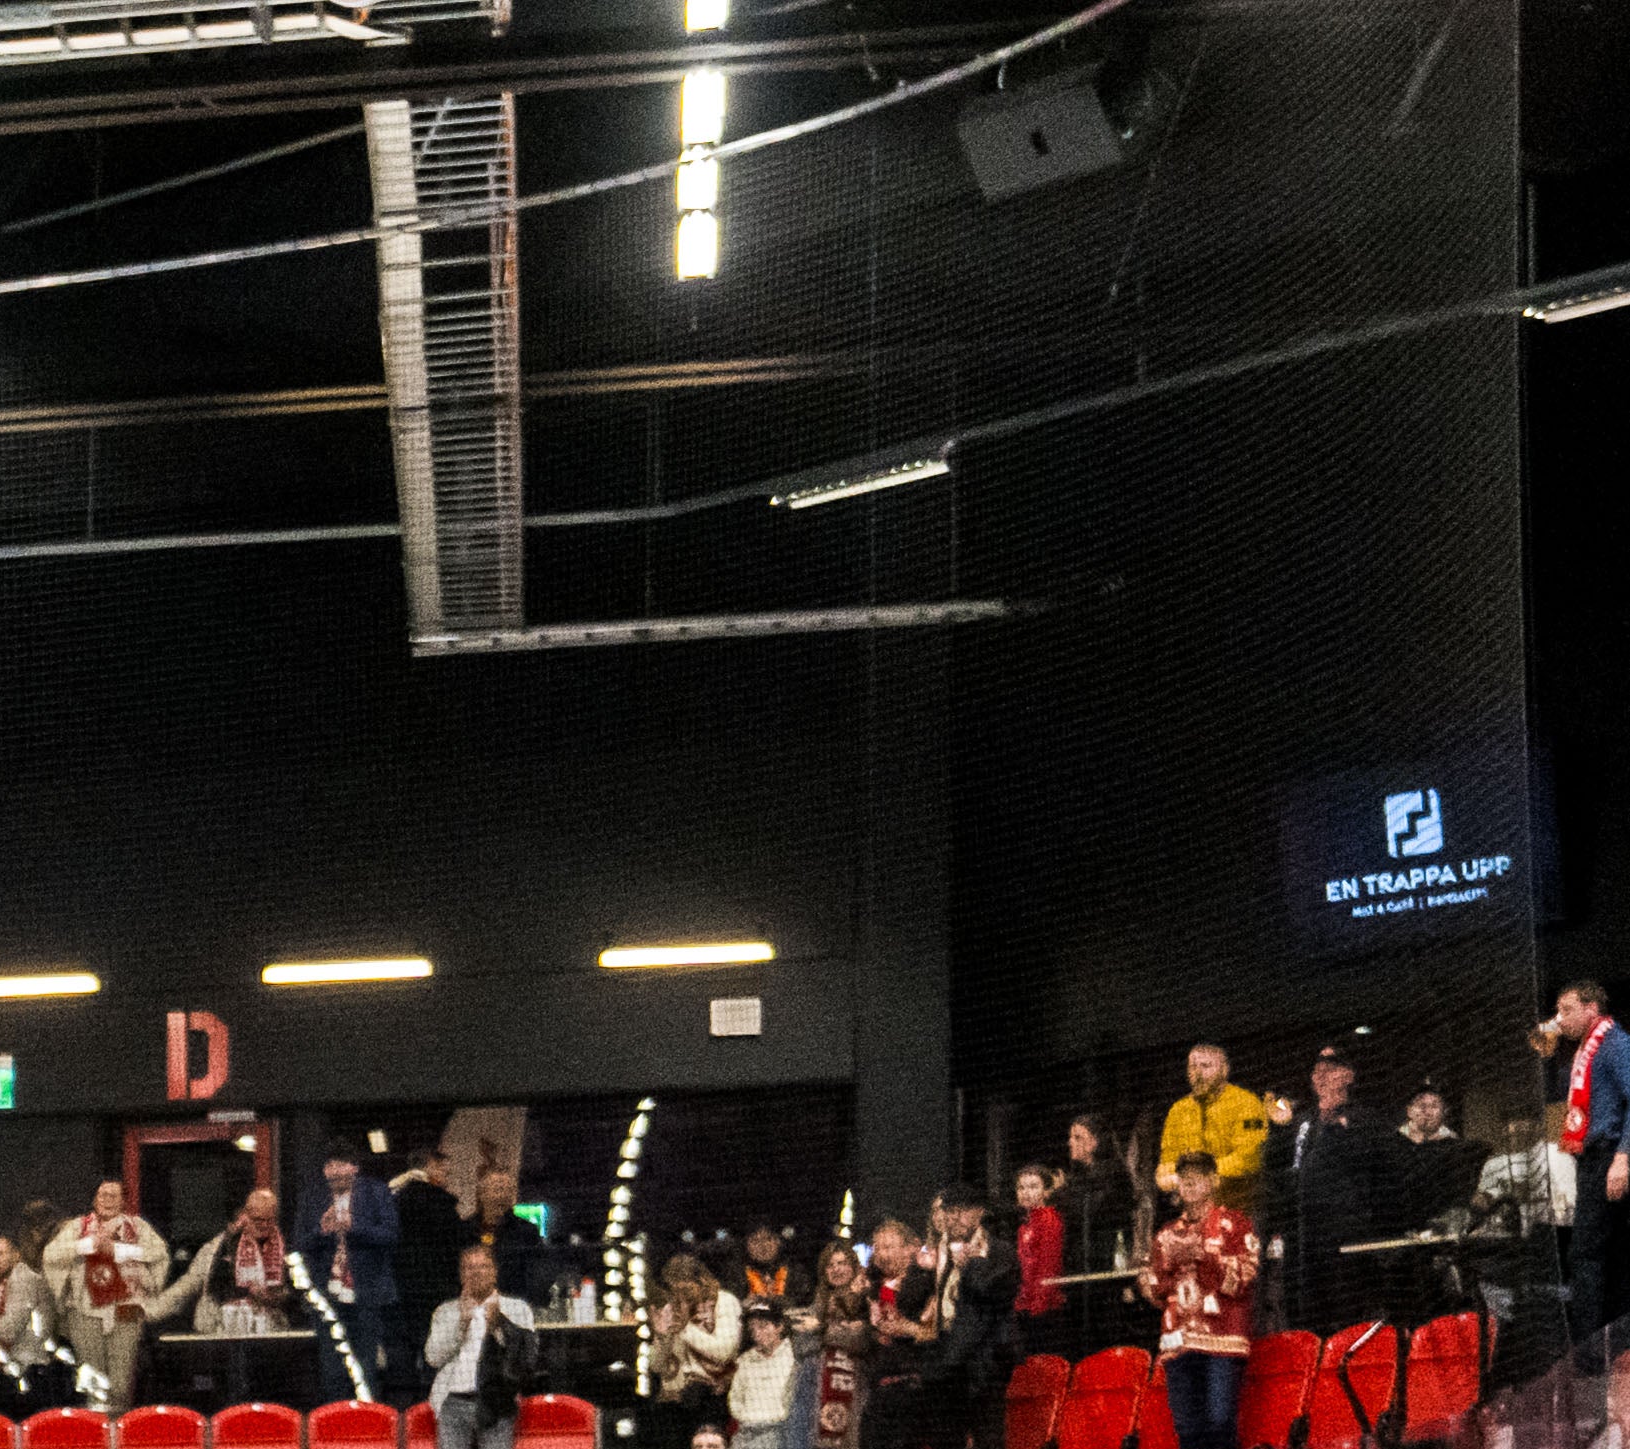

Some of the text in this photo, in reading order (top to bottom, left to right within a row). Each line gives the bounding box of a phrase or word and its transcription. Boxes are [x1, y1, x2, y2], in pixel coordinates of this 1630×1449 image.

[1326, 877, 1359, 903] EN
[1362, 864, 1458, 896] TRAPPA
[166, 1012, 230, 1100] D
